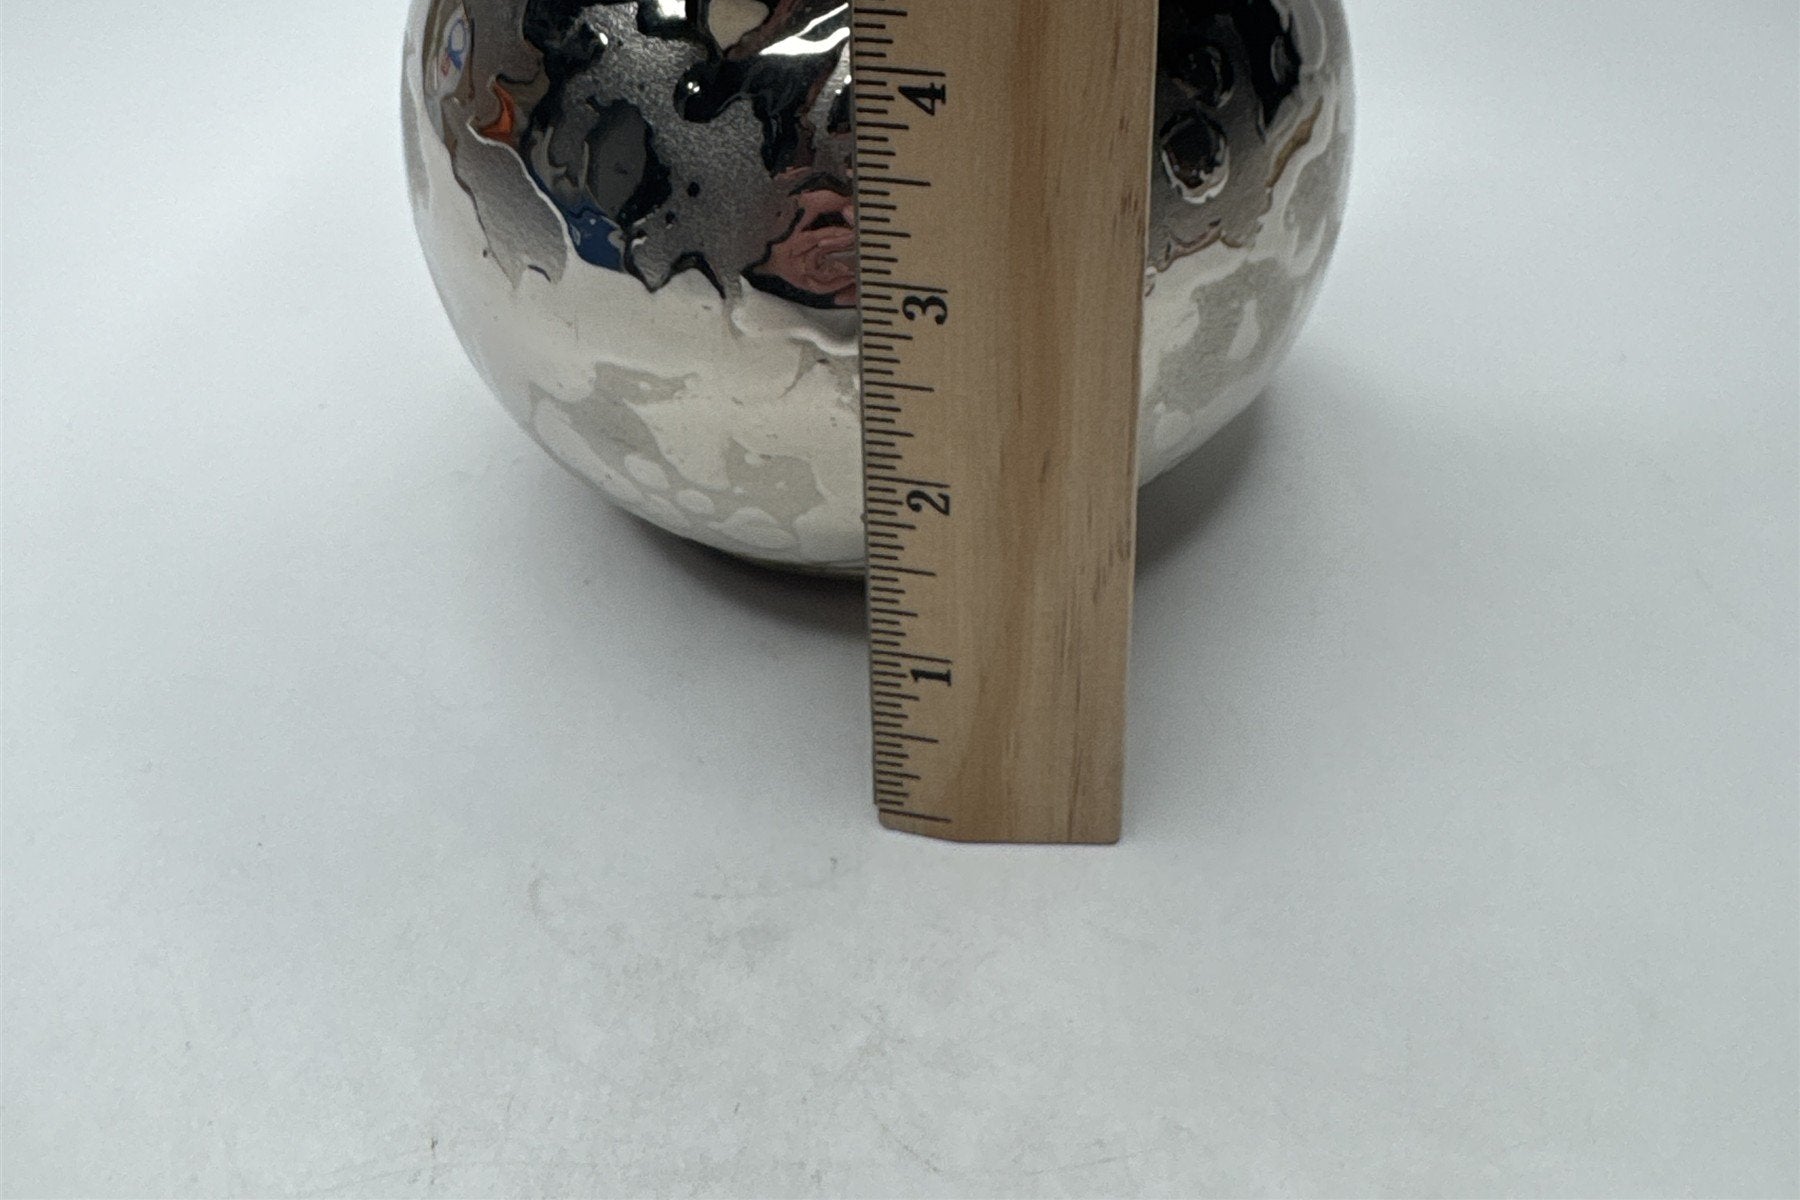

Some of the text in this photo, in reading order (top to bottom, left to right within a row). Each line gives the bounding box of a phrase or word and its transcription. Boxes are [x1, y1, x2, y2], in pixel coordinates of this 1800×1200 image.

[898, 82, 946, 116] 4
[902, 295, 948, 326] 3
[906, 490, 951, 516] 2
[909, 667, 952, 688] 1
